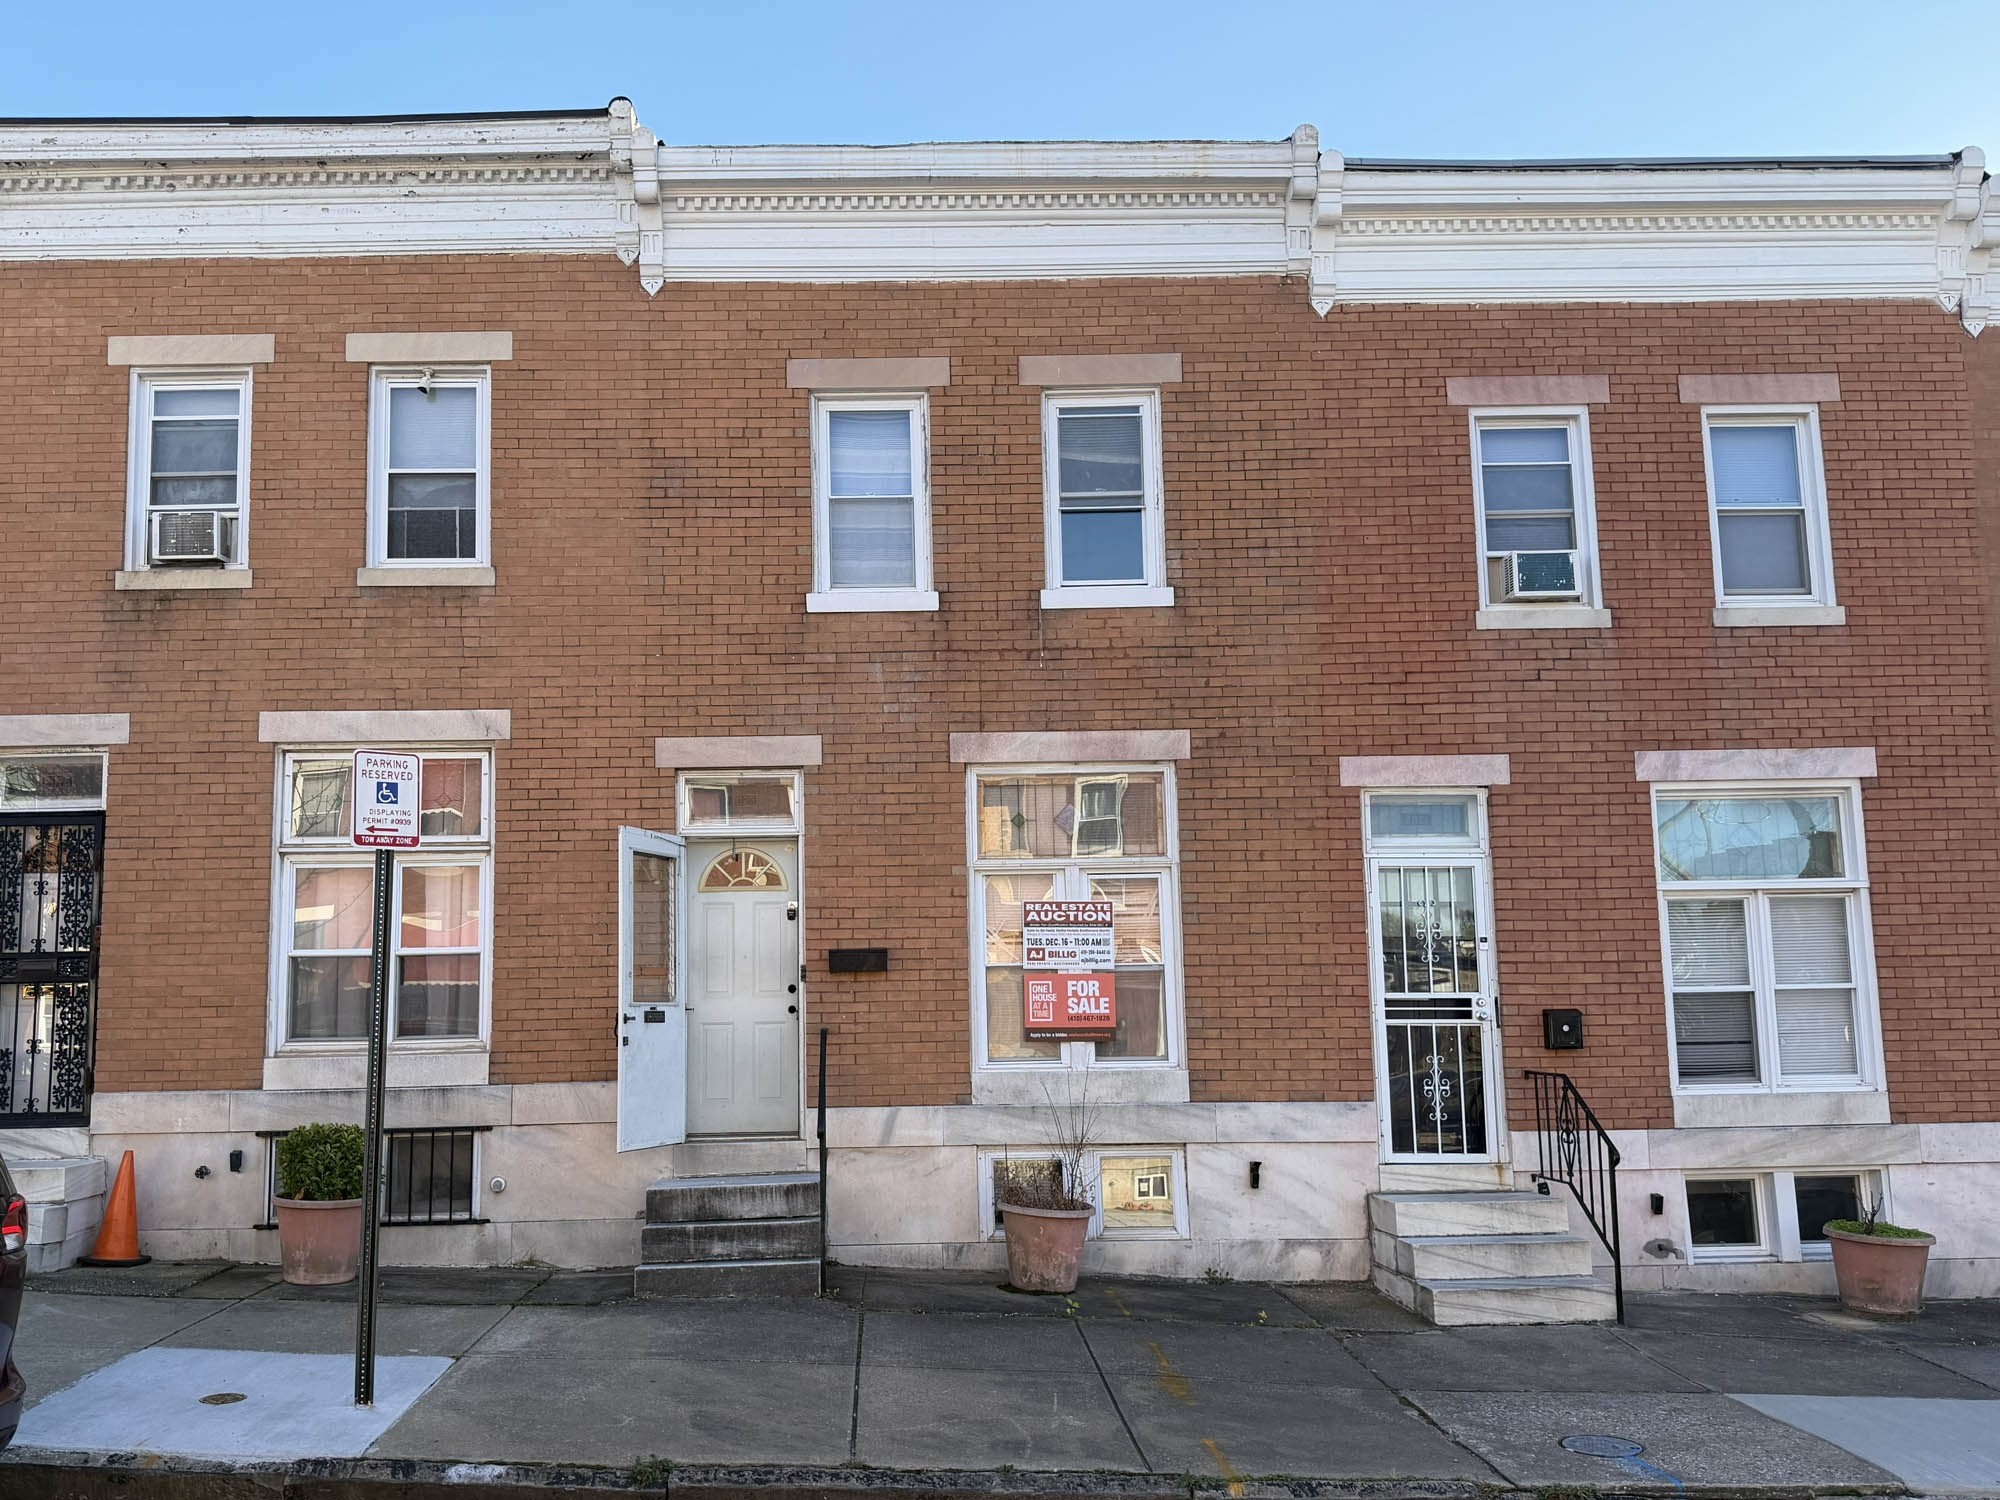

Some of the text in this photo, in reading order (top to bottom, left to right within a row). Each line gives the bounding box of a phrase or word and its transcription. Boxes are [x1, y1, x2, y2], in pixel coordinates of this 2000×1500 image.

[366, 758, 408, 769] PARKING
[361, 769, 413, 780] RESERVED
[369, 808, 411, 816] DISPLAYING
[1026, 903, 1111, 911] REAL ESTATE
[1026, 911, 1111, 921] AUCTION
[1026, 938, 1044, 946] TUES.
[1045, 938, 1060, 946] DEC.
[1061, 938, 1068, 946] 16
[1074, 938, 1089, 946] 11:00
[1090, 938, 1101, 946] AM
[1029, 950, 1077, 959] AJ BILLIG
[1032, 985, 1048, 993] ONE
[1067, 980, 1100, 996] FOR
[1032, 993, 1057, 1002] HOUSE
[1032, 1002, 1048, 1010] AT A
[1067, 997, 1110, 1014] SALE
[1033, 1010, 1049, 1018] TIME
